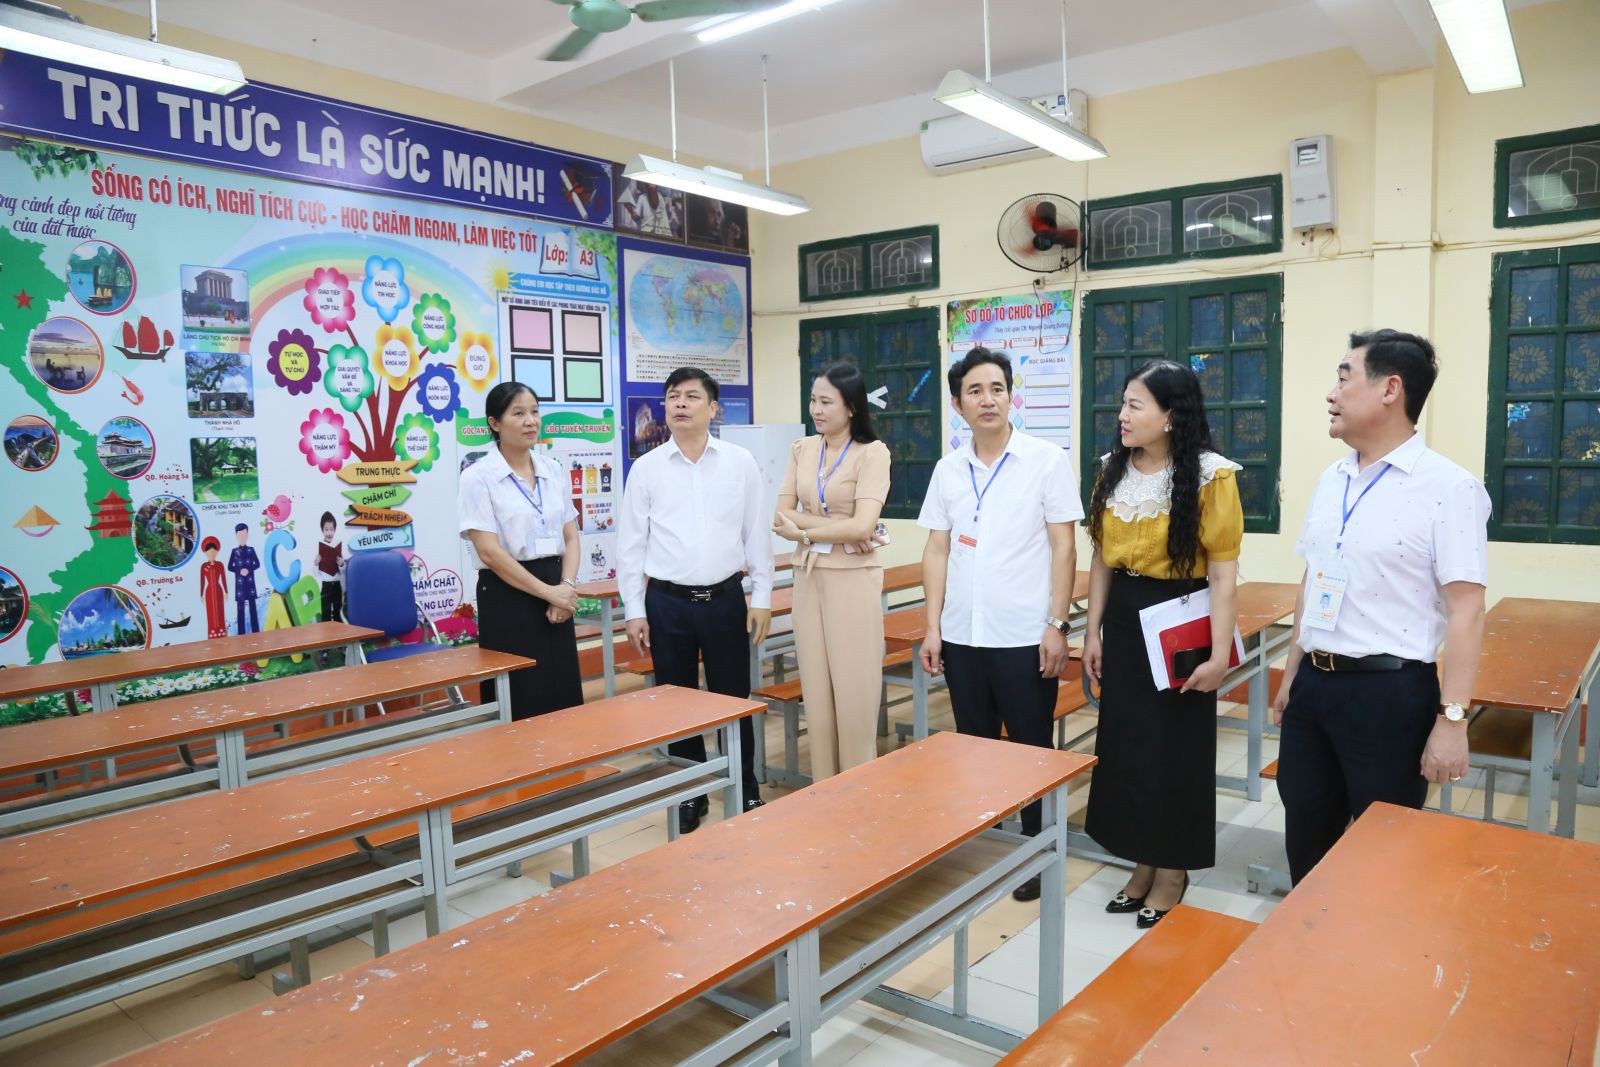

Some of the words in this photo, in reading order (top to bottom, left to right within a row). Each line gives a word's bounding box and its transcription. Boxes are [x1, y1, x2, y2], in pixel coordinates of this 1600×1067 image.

[47, 67, 139, 132] TRI
[157, 91, 281, 157] THỨC
[297, 110, 345, 169] LÀ
[360, 128, 430, 184] SỨC
[442, 149, 545, 204] MẠNH!
[22, 196, 54, 214] cảnh
[58, 198, 81, 222] đẹp
[85, 203, 103, 220] nổi
[105, 204, 137, 230] tiếng
[91, 163, 143, 201] SỐNG
[148, 175, 172, 207] CÓ
[177, 177, 211, 213] ÍCH,
[216, 187, 255, 216] NGHĨ
[259, 190, 293, 221] TÍCH
[298, 199, 327, 229] CỰC
[341, 206, 368, 234] HỌC
[372, 208, 410, 237] CHĂM
[415, 217, 461, 246] NGOAN,
[464, 223, 488, 248] LÀM
[491, 226, 516, 254] VIỆC
[518, 227, 538, 253] TỐT
[13, 217, 38, 234] của
[42, 218, 63, 237] đất
[64, 223, 97, 239] nước
[545, 244, 568, 265] Lớp:
[579, 250, 594, 266] A3
[965, 309, 977, 324] SƠ
[980, 304, 992, 323] ĐỒ
[994, 303, 1005, 321] TỔ
[1008, 302, 1032, 320] CHỨC
[1035, 300, 1053, 318] LỚP
[545, 424, 559, 433] GÓC
[159, 473, 180, 481] Hoàng
[355, 467, 380, 476] TRUNG
[380, 467, 401, 478] THỰC
[362, 492, 383, 505] CHĂM
[383, 489, 397, 499] CHỈ
[360, 511, 383, 520] TRÁCH
[383, 514, 407, 523] NHIỆM
[358, 536, 372, 547] YÊU
[373, 532, 394, 544] NƯỚC
[136, 579, 149, 588] QĐ.
[150, 576, 173, 585] Trường
[412, 576, 431, 590] HẨM
[433, 575, 456, 588] CHẤT
[437, 598, 454, 610] LỰC
